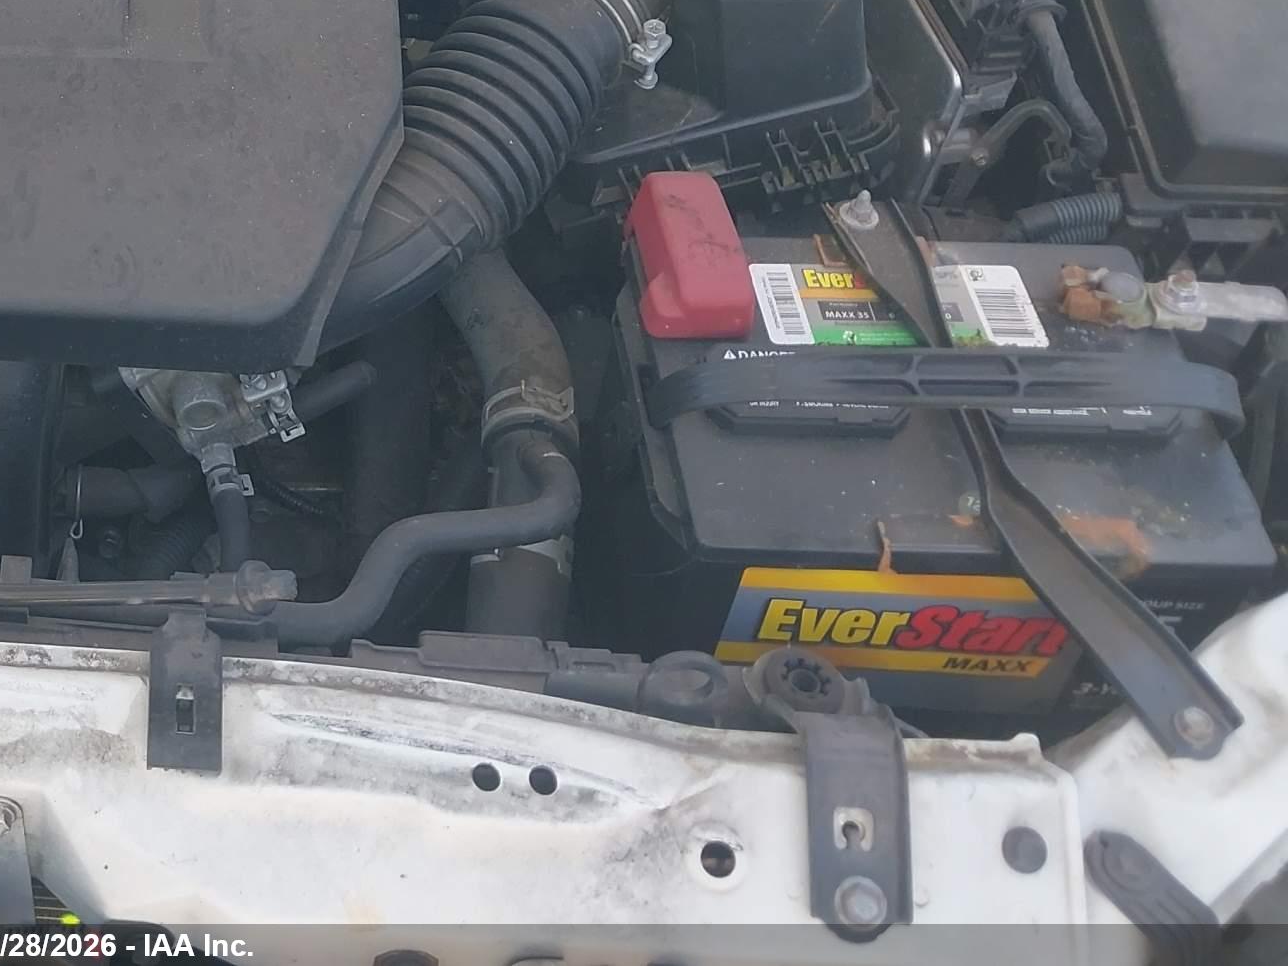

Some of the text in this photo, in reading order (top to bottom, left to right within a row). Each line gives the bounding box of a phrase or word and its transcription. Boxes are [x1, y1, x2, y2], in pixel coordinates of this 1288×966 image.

[800, 267, 868, 289] Ever
[824, 310, 856, 319] MAXX
[942, 656, 1032, 673] MAXX
